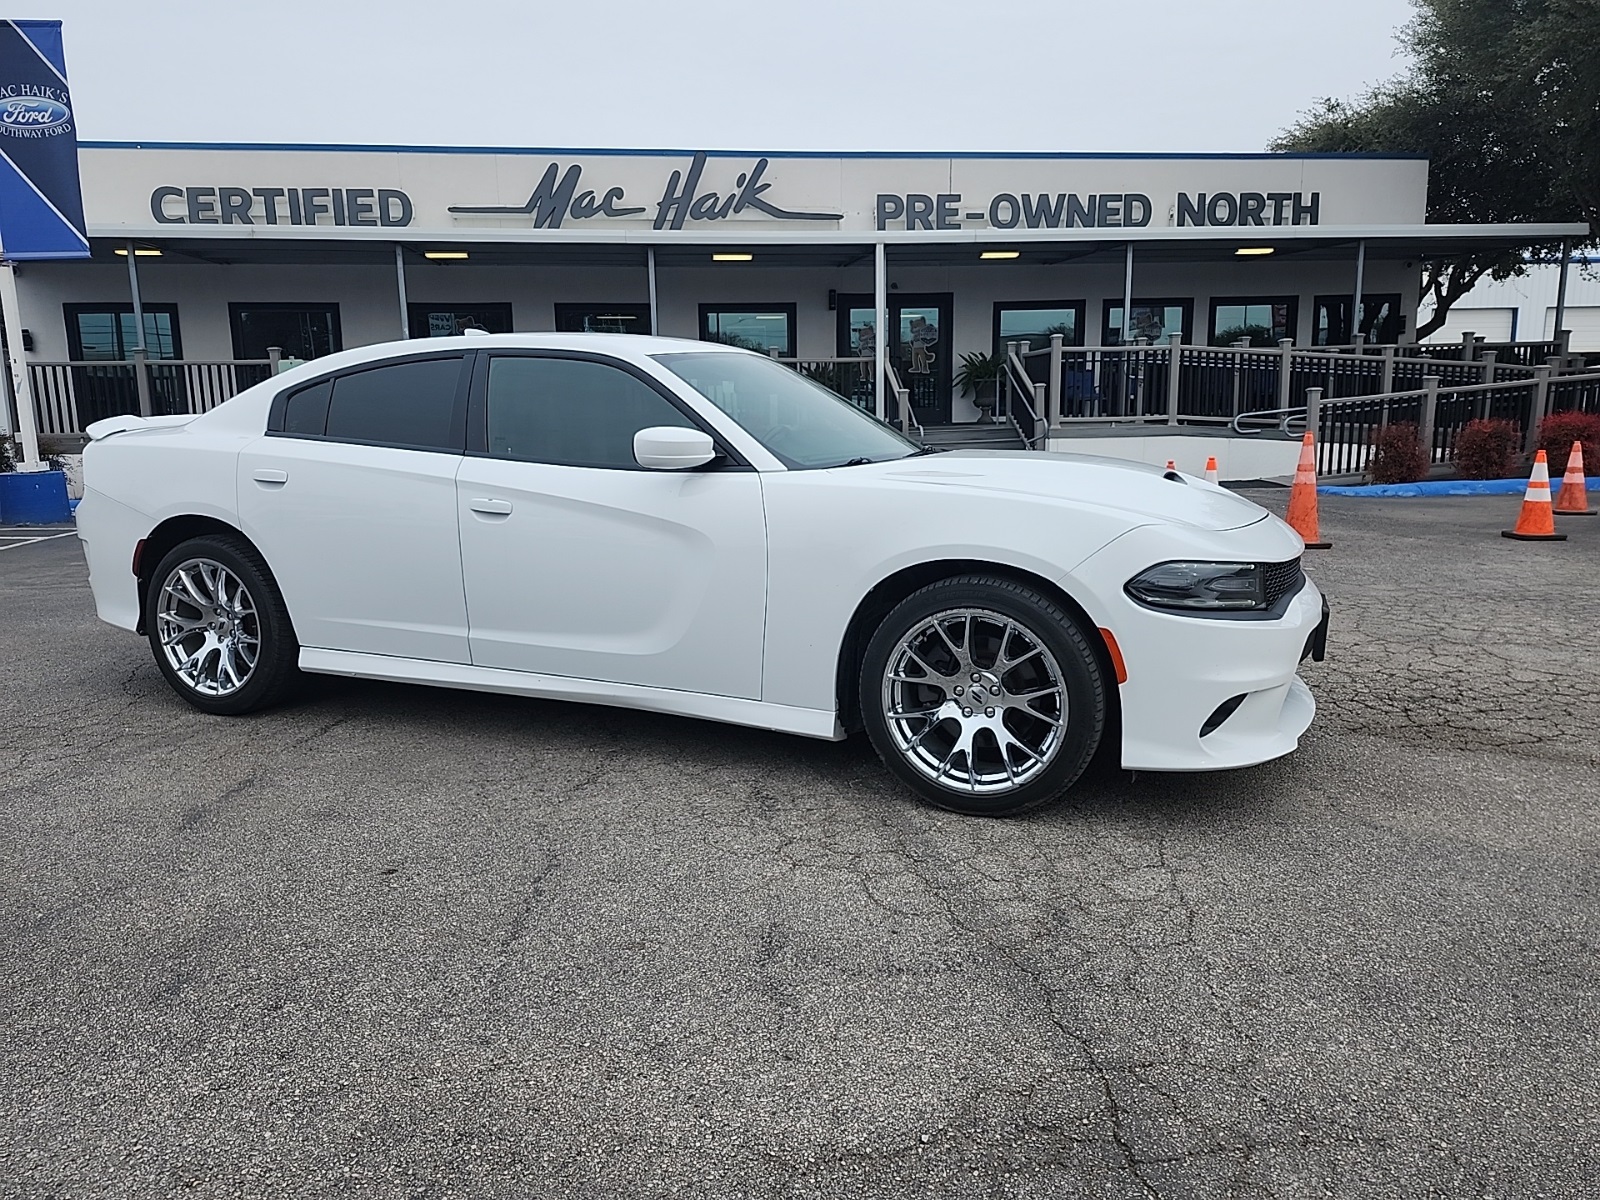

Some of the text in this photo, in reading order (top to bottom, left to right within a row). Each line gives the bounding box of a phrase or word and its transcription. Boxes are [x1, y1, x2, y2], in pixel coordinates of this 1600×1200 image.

[21, 84, 68, 103] HAIK'S
[3, 101, 53, 123] Ford
[44, 123, 72, 137] FORD
[448, 151, 844, 230] Mac Haik
[150, 186, 413, 227] CERTIFIED
[876, 192, 1320, 230] PRE-OWNED NORTH
